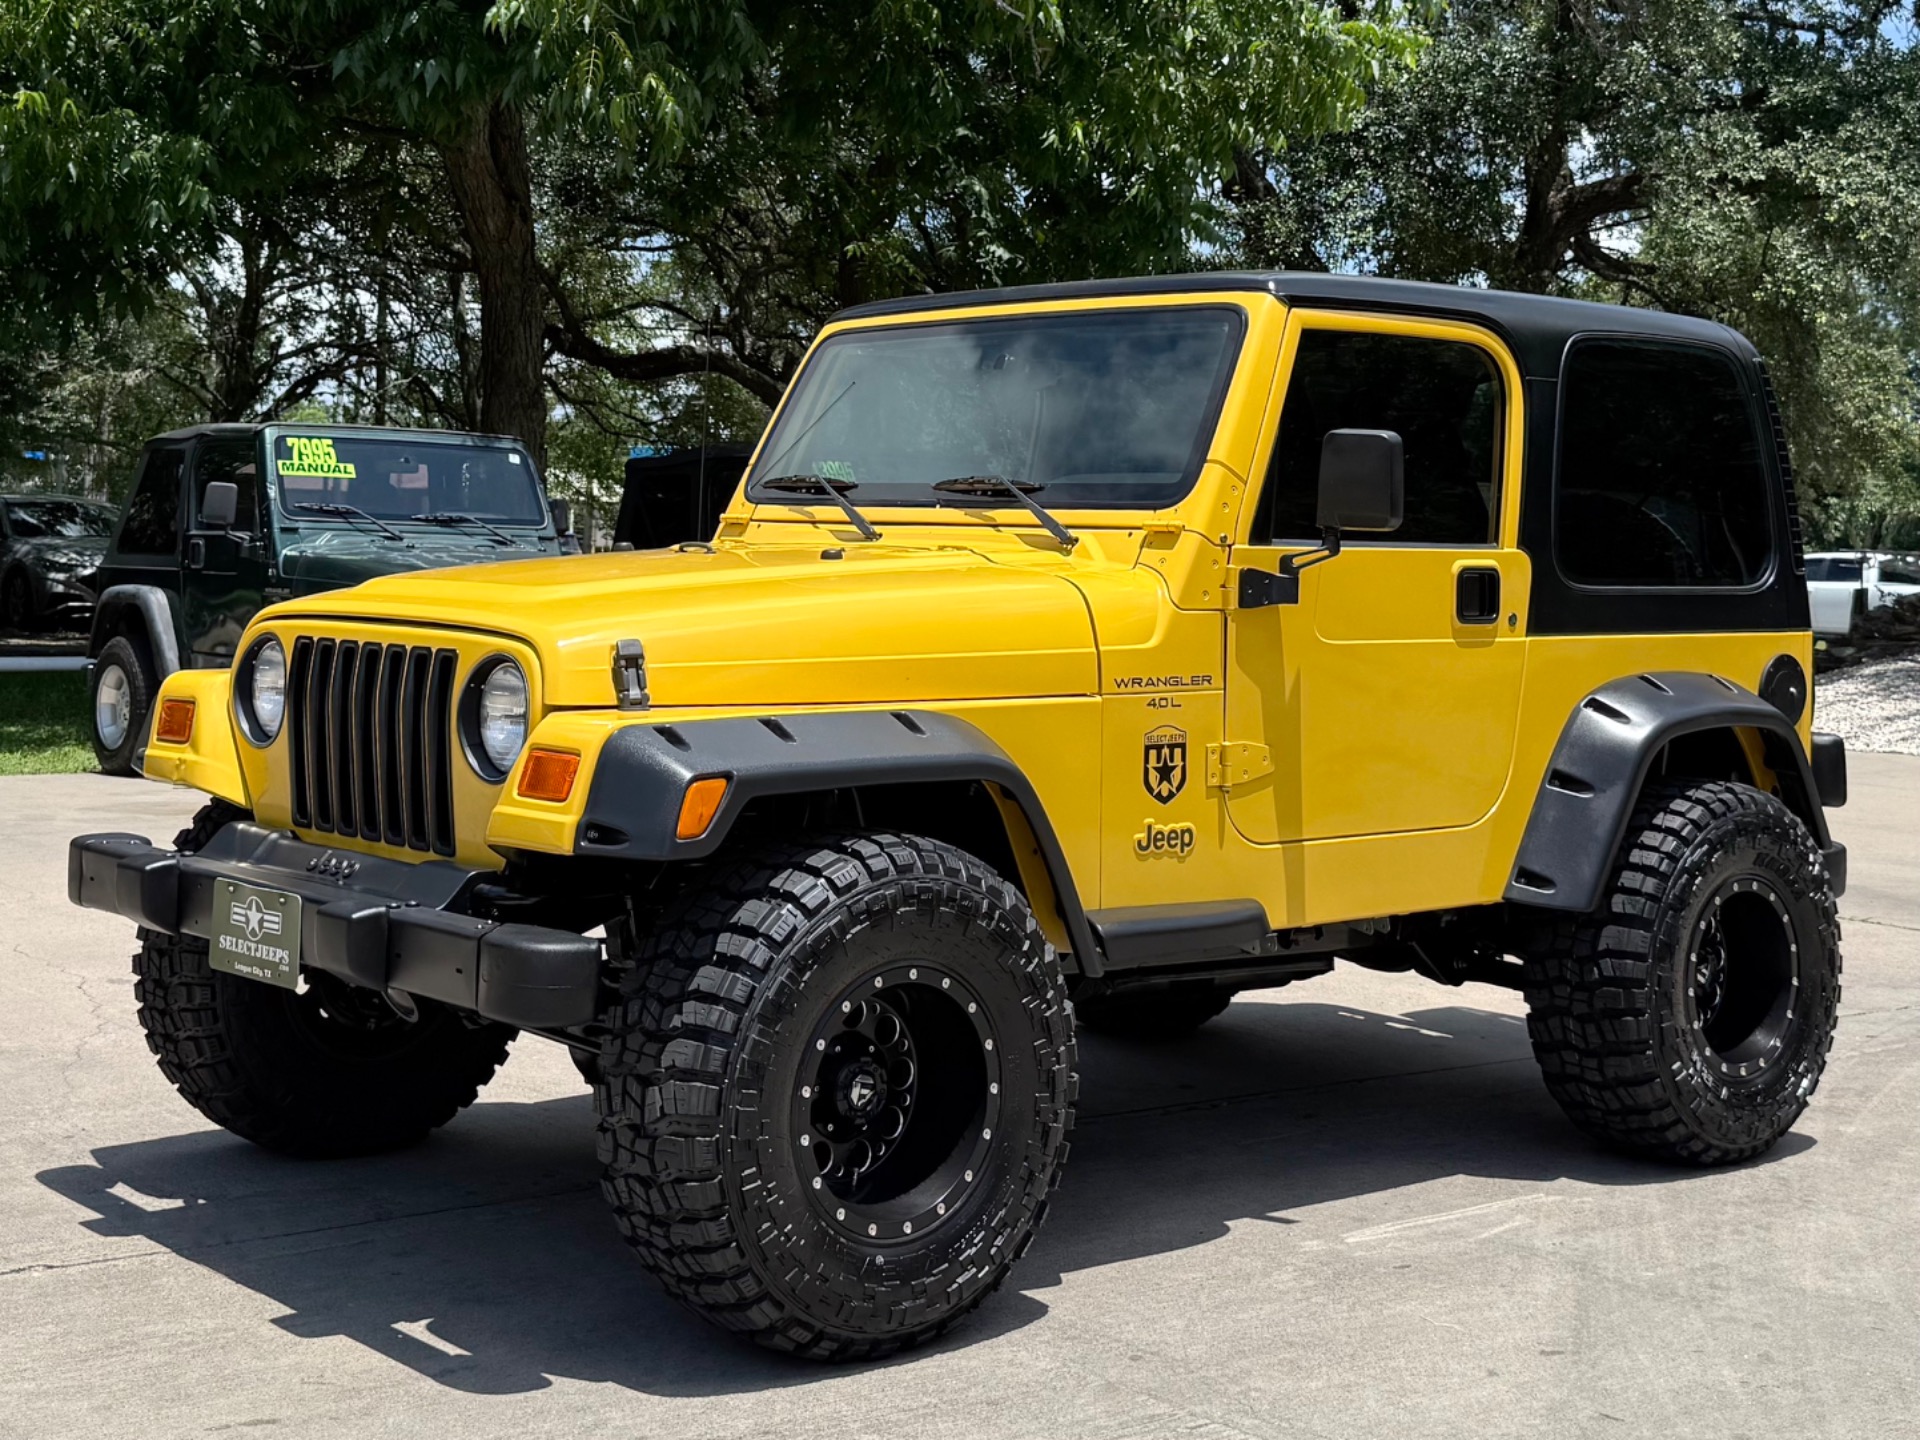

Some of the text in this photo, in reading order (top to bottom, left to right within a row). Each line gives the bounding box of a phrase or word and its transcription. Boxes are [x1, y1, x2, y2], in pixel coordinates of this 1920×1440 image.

[285, 437, 337, 463] 7995
[281, 462, 353, 475] MANUAL
[1114, 674, 1213, 689] WRANGLER
[1136, 822, 1195, 854] Jeep
[219, 934, 290, 965] SELECTJEEPS
